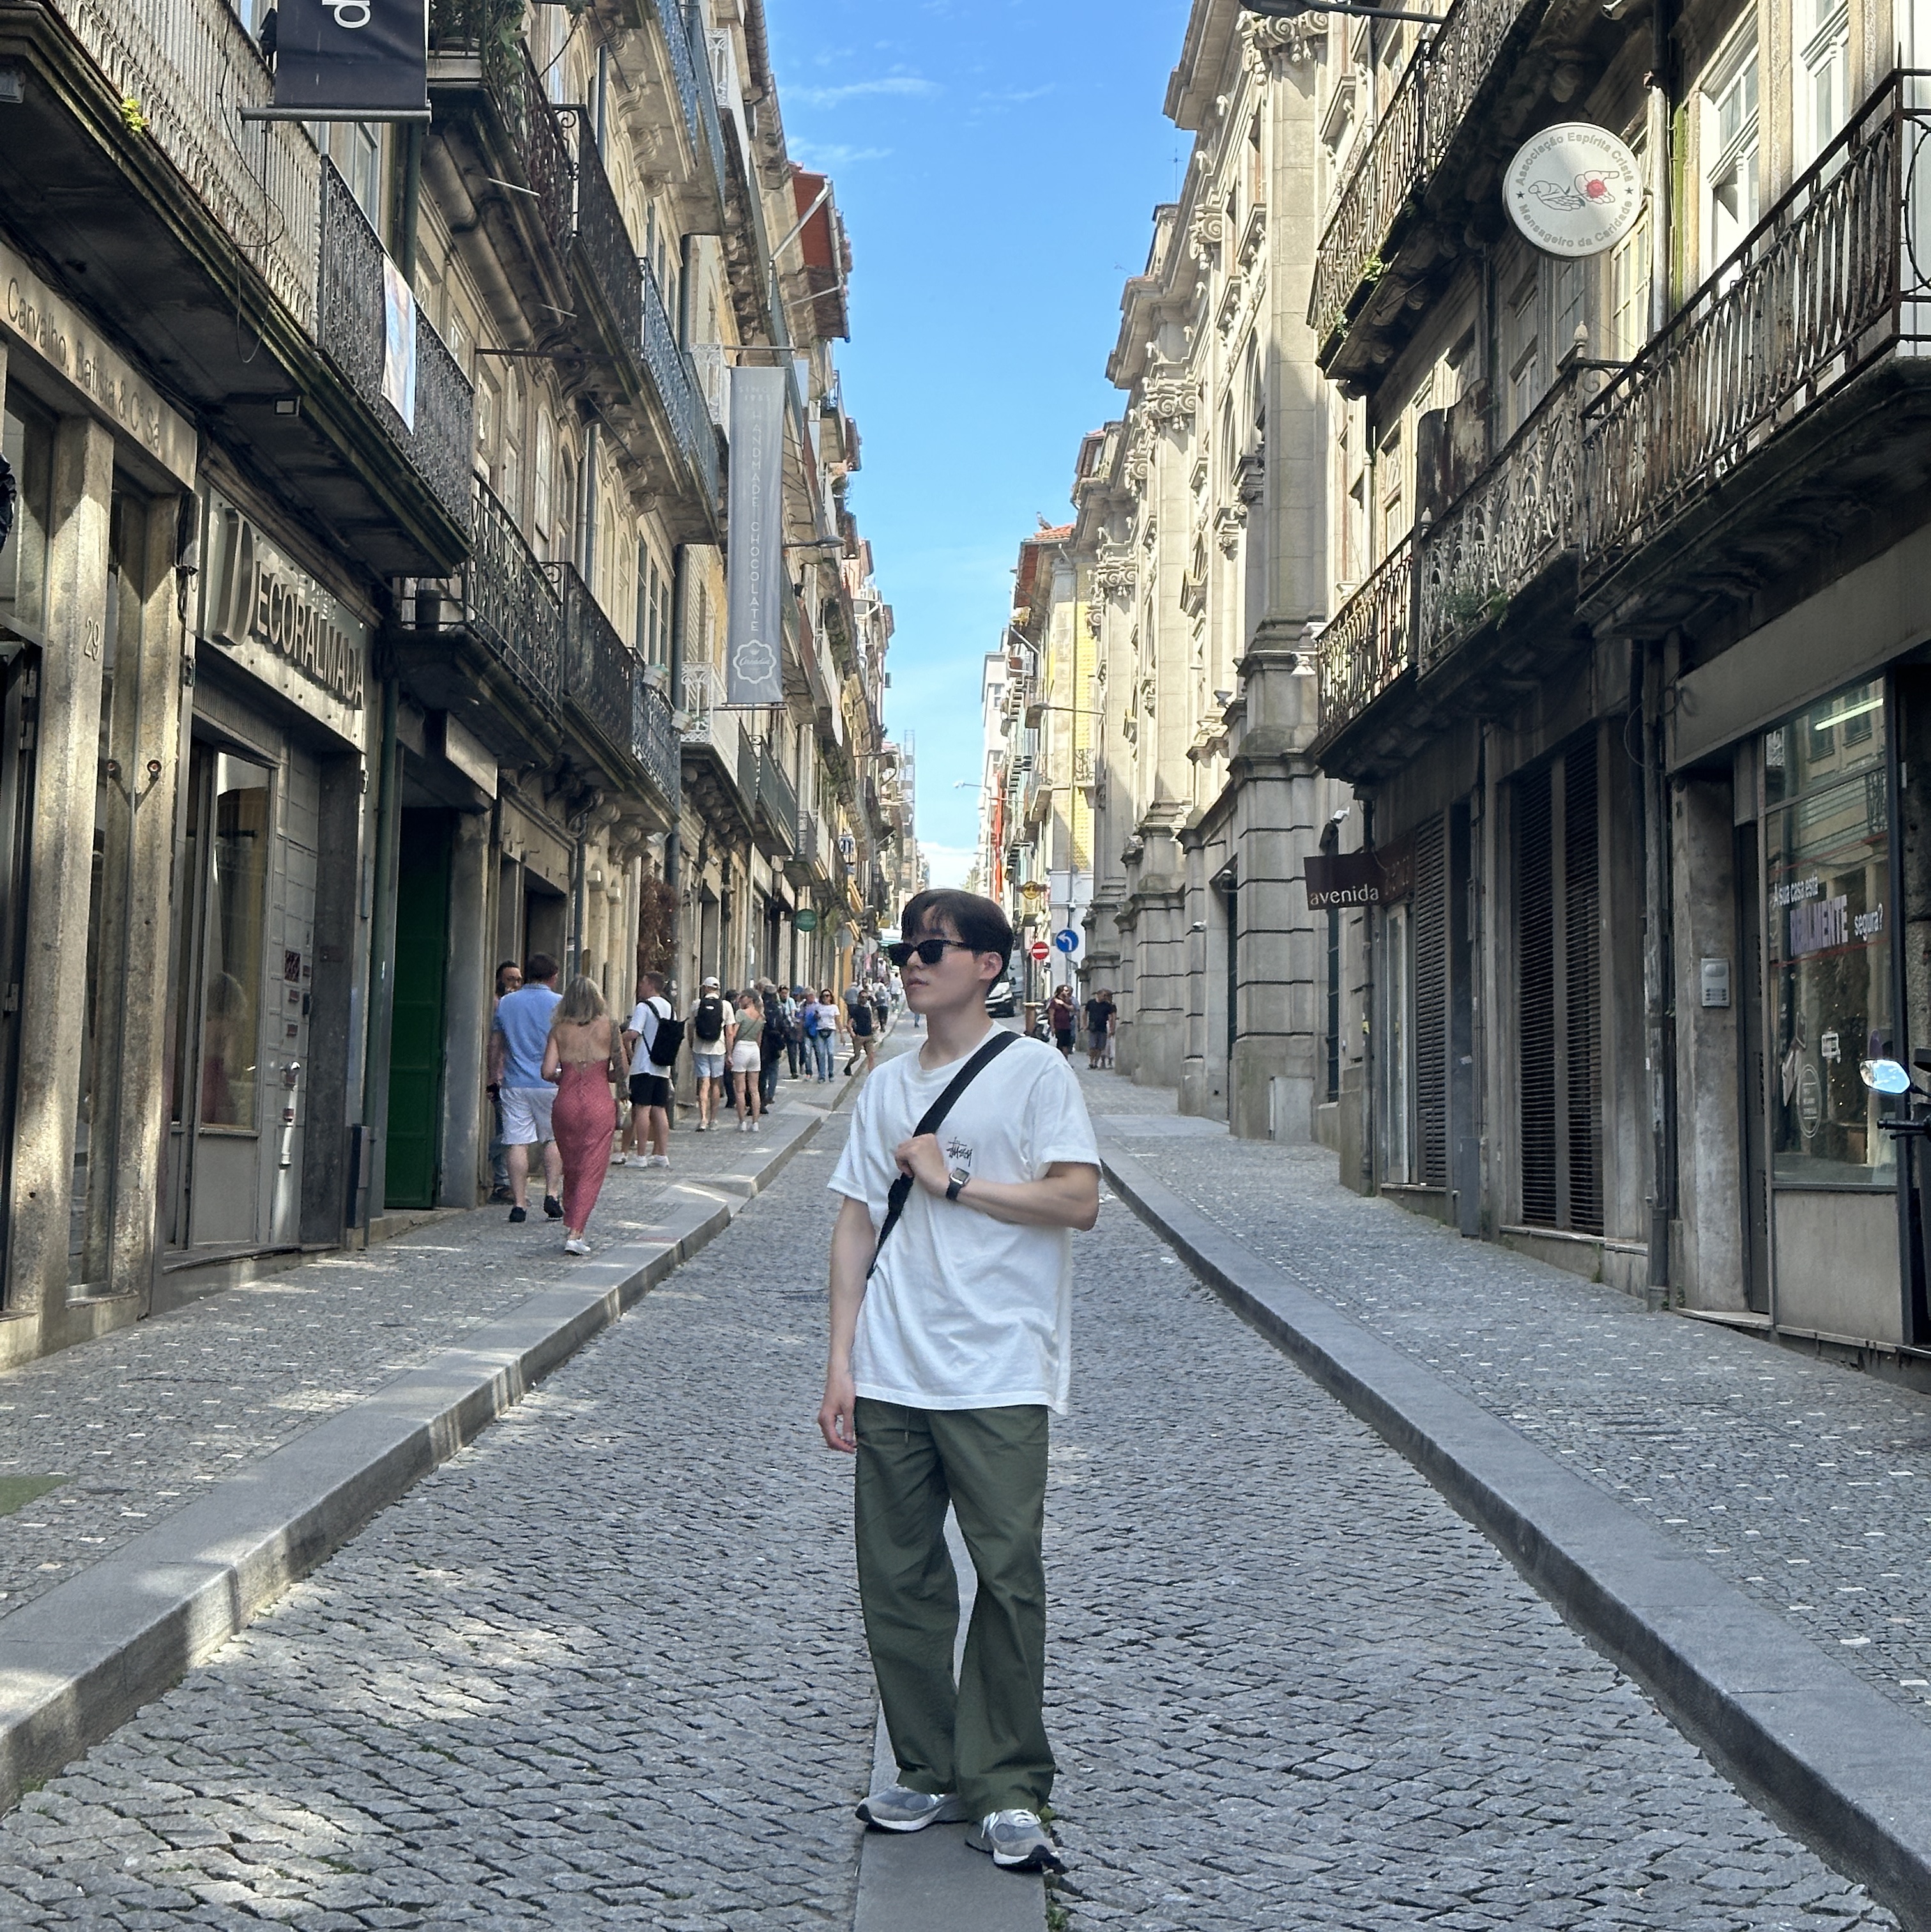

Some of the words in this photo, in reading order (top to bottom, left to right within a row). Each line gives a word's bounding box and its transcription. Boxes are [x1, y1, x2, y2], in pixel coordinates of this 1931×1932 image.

[1515, 135, 1564, 186] Associação
[1567, 132, 1612, 153] Espírita
[1611, 150, 1634, 183] Cristã
[1518, 203, 1575, 247] Mensageiro
[1578, 237, 1593, 247] da
[1594, 201, 1633, 242] Caridade
[7, 277, 70, 377] Carvalho,
[75, 339, 116, 413] Batista
[118, 379, 126, 422] &
[752, 411, 762, 507] HANDMADE
[750, 521, 760, 632] CHOCOLATE
[84, 616, 100, 661] 29
[1310, 883, 1380, 905] avenida
[1854, 902, 1883, 941] segura?
